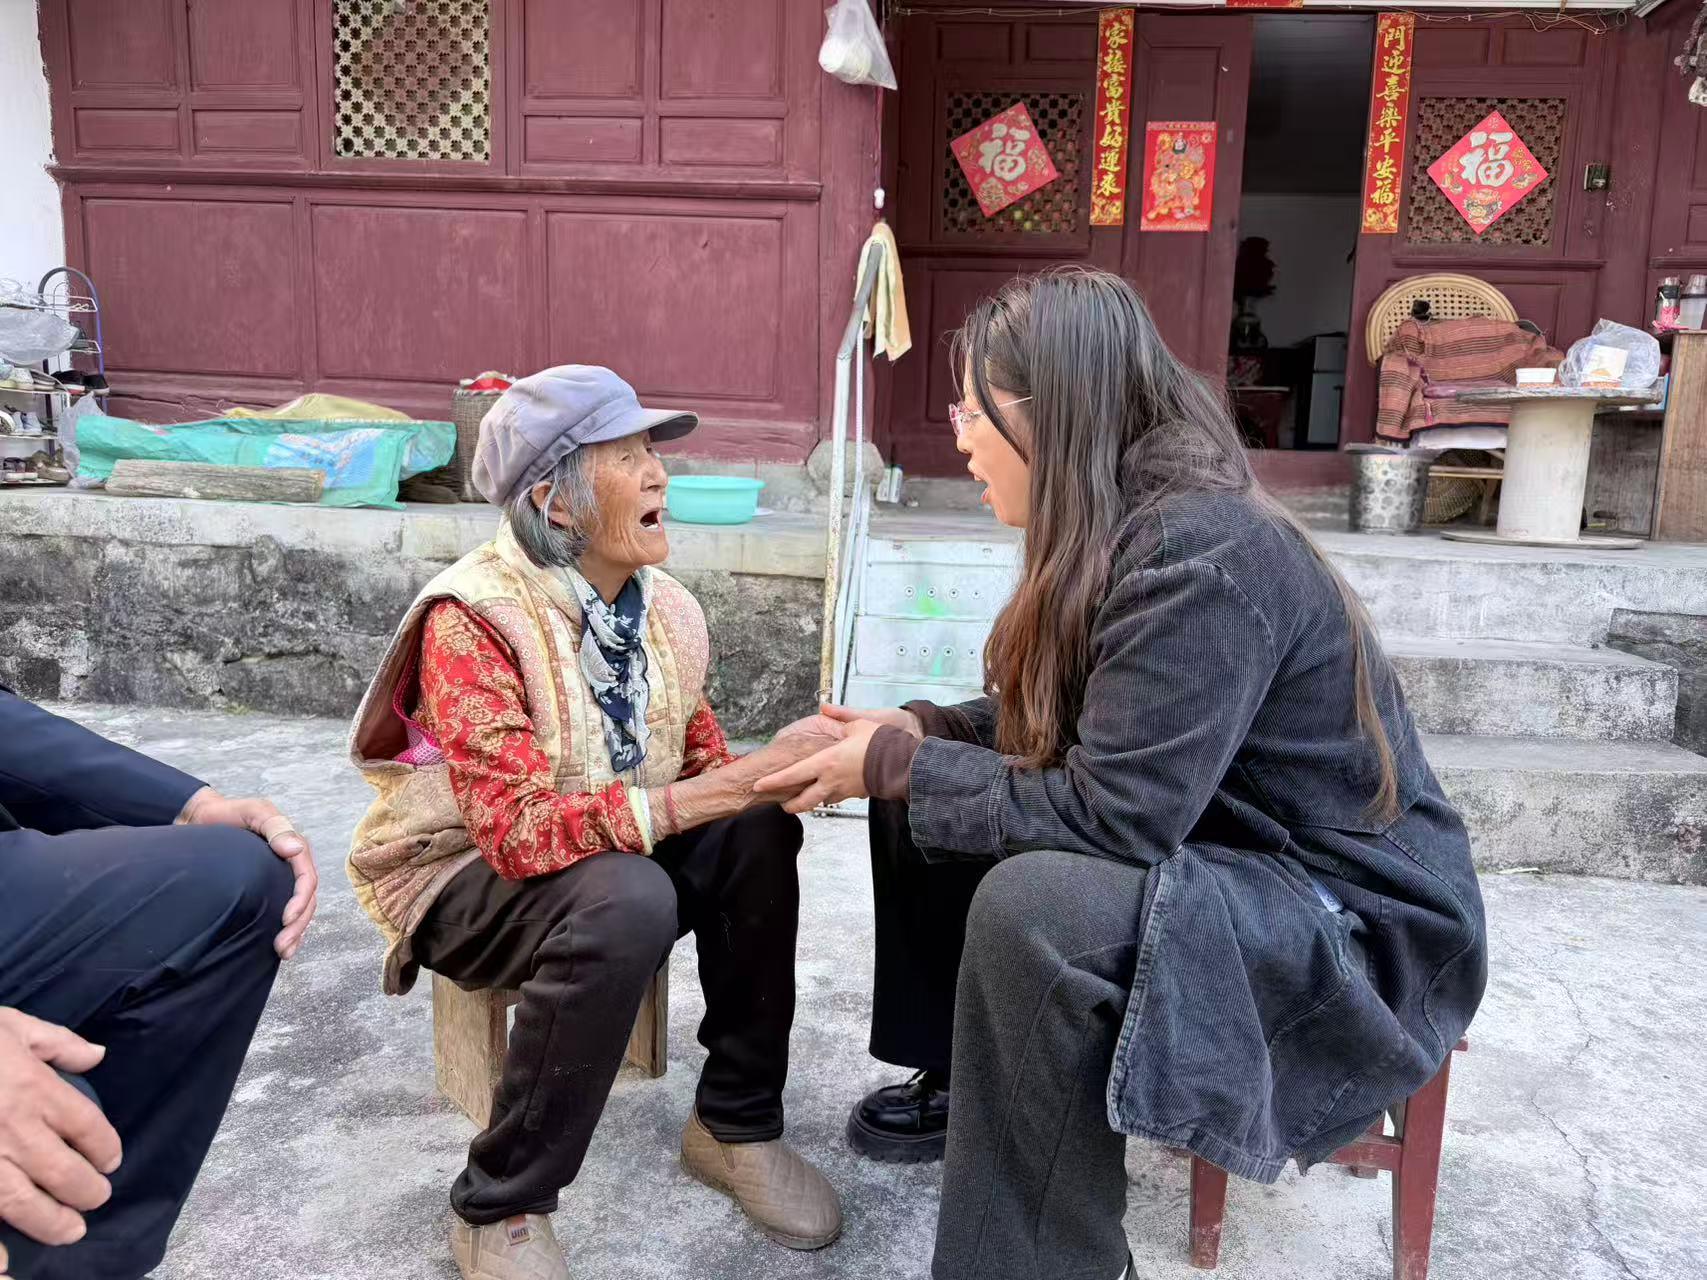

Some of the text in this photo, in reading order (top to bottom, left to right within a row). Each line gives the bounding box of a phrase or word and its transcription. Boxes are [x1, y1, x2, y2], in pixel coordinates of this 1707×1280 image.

[1370, 26, 1406, 205] 門迎喜樂平安福
[978, 123, 1030, 181] 福
[1459, 131, 1514, 188] 福
